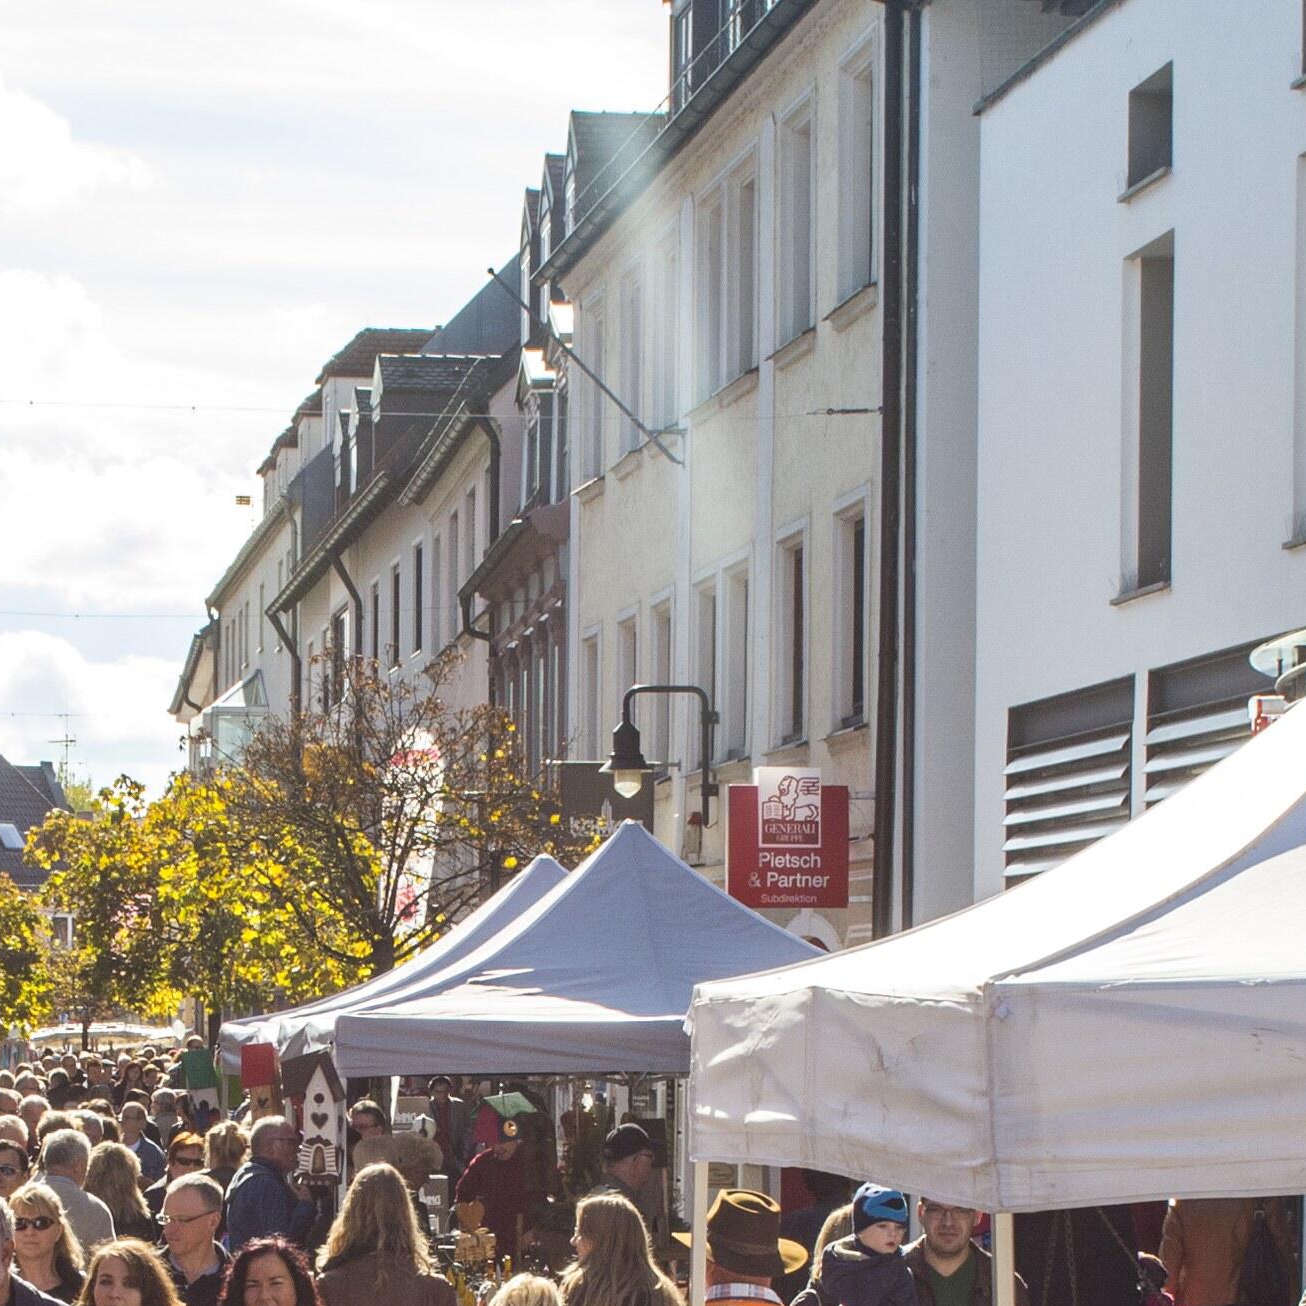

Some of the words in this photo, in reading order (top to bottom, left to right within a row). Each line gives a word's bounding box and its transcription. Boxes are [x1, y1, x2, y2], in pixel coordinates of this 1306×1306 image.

[764, 823, 816, 835] GENERALI
[758, 852, 821, 869] Pietsch
[749, 873, 761, 887] &
[766, 872, 830, 887] Partner
[760, 894, 817, 904] Subdirektion
